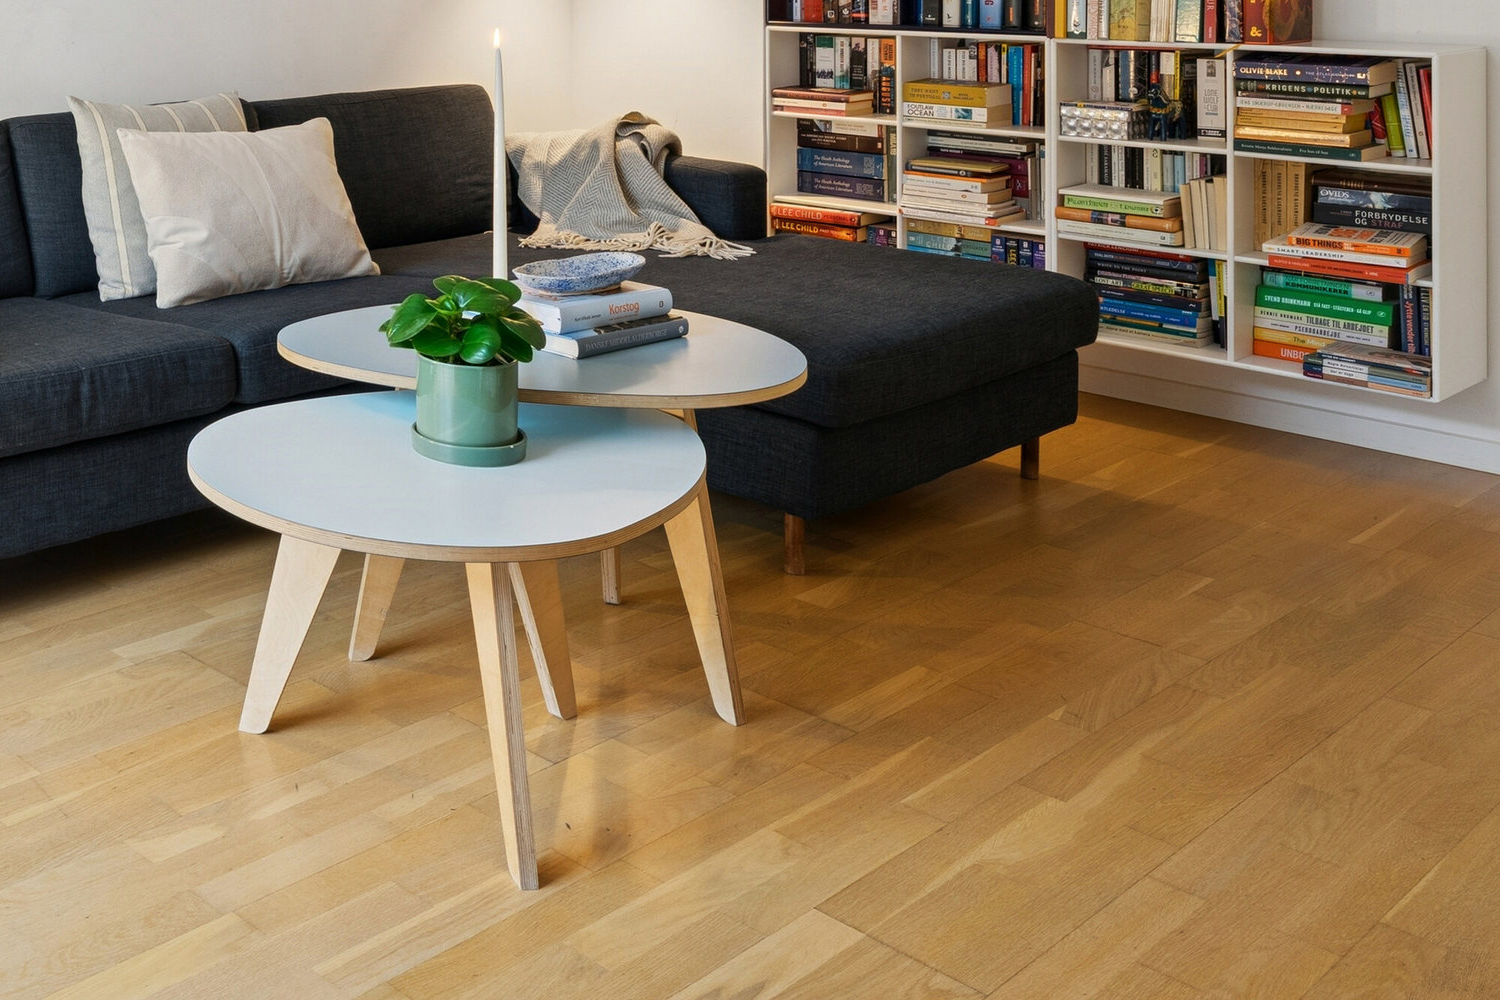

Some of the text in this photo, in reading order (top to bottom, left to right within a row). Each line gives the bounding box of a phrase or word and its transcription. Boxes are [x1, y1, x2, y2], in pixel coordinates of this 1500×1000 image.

[1239, 66, 1288, 77] OLIVIE BLAKE
[881, 76, 891, 109] AUGUST
[1265, 84, 1352, 96] KRIGENS POLITIK
[907, 103, 935, 118] OUTLAW OCEAN
[1319, 188, 1350, 199] OVIDS
[776, 205, 794, 218] LEE
[795, 207, 823, 221] CHILD
[1355, 210, 1429, 230] FORBRYDELSE OG STRAF
[1295, 236, 1344, 250] BIG THINGS
[1302, 249, 1345, 259] LEADERSHIP
[1285, 282, 1350, 296] KOMMUNIKERER
[608, 301, 641, 316] Korstog
[1294, 325, 1341, 339] PSEUDOARBEJDE
[1305, 315, 1331, 327] TILBAGE
[1331, 318, 1341, 328] TIL
[1342, 320, 1375, 335] ARBEJDET
[1293, 336, 1306, 344] The
